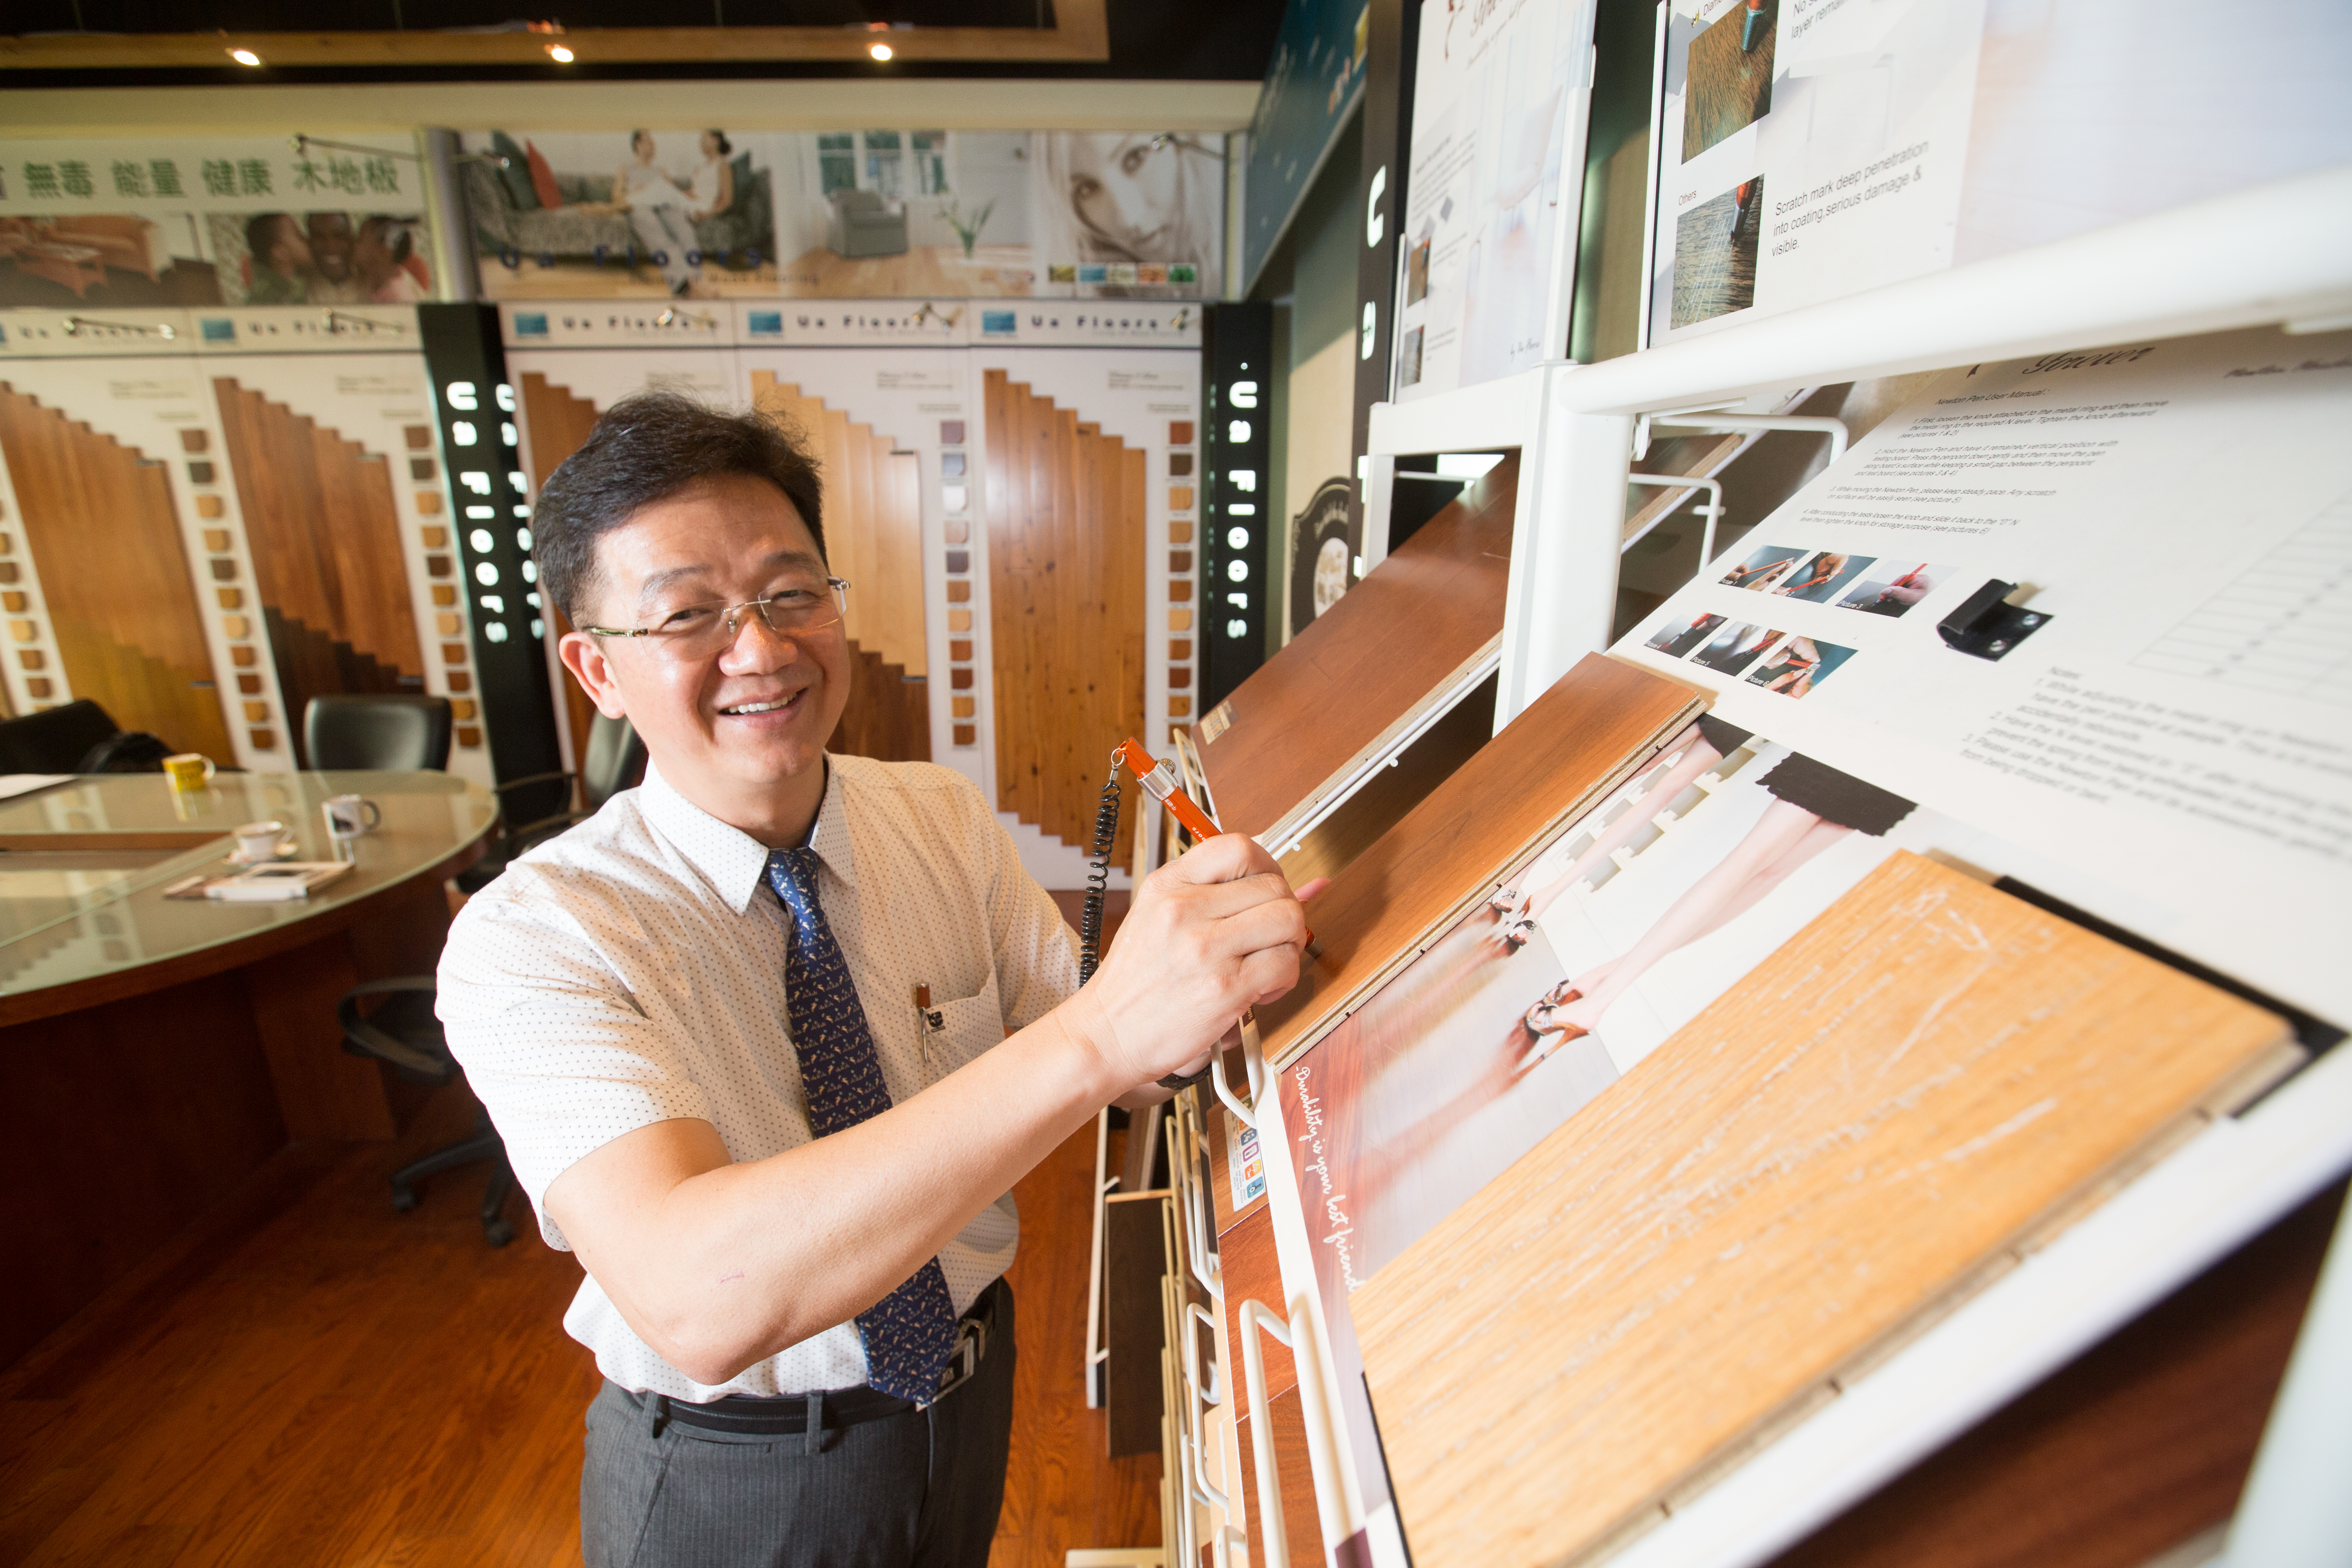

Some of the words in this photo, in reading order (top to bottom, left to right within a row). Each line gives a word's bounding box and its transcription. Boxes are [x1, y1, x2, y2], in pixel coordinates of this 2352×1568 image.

[1791, 16, 1813, 39] layer
[24, 160, 95, 199] 無毒
[111, 158, 188, 198] 能量
[200, 157, 276, 197] 健康
[292, 155, 402, 196] 木地板
[1775, 191, 1808, 216] Scratch
[1810, 180, 1834, 201] mark
[1836, 170, 1862, 190] deep
[1864, 140, 1930, 181] penetration
[1678, 189, 1697, 206] Others
[1773, 222, 1788, 237] into
[1864, 173, 1910, 201] damage
[1913, 165, 1923, 181] &
[1772, 238, 1800, 257] visible.
[1077, 315, 1158, 329] Floors
[447, 381, 478, 446] Ua
[1228, 380, 1258, 444] Ua
[1992, 410, 2028, 419] attached
[1973, 419, 2006, 428] required
[2036, 416, 2068, 424] Tighten
[1939, 453, 1971, 461] penpoint
[2008, 489, 2026, 497] Any
[1946, 526, 1978, 534] pictures
[460, 471, 508, 644] Floors
[1227, 469, 1256, 639] Floors
[1838, 600, 1858, 609] Picture
[1645, 640, 1658, 649] Picture
[1691, 656, 1707, 665] Picture
[1747, 675, 1765, 685] Picture
[1312, 1138, 1325, 1154] is
[1306, 1155, 1333, 1195] your
[1326, 1195, 1349, 1228] best
[1323, 1227, 1367, 1293] friend
